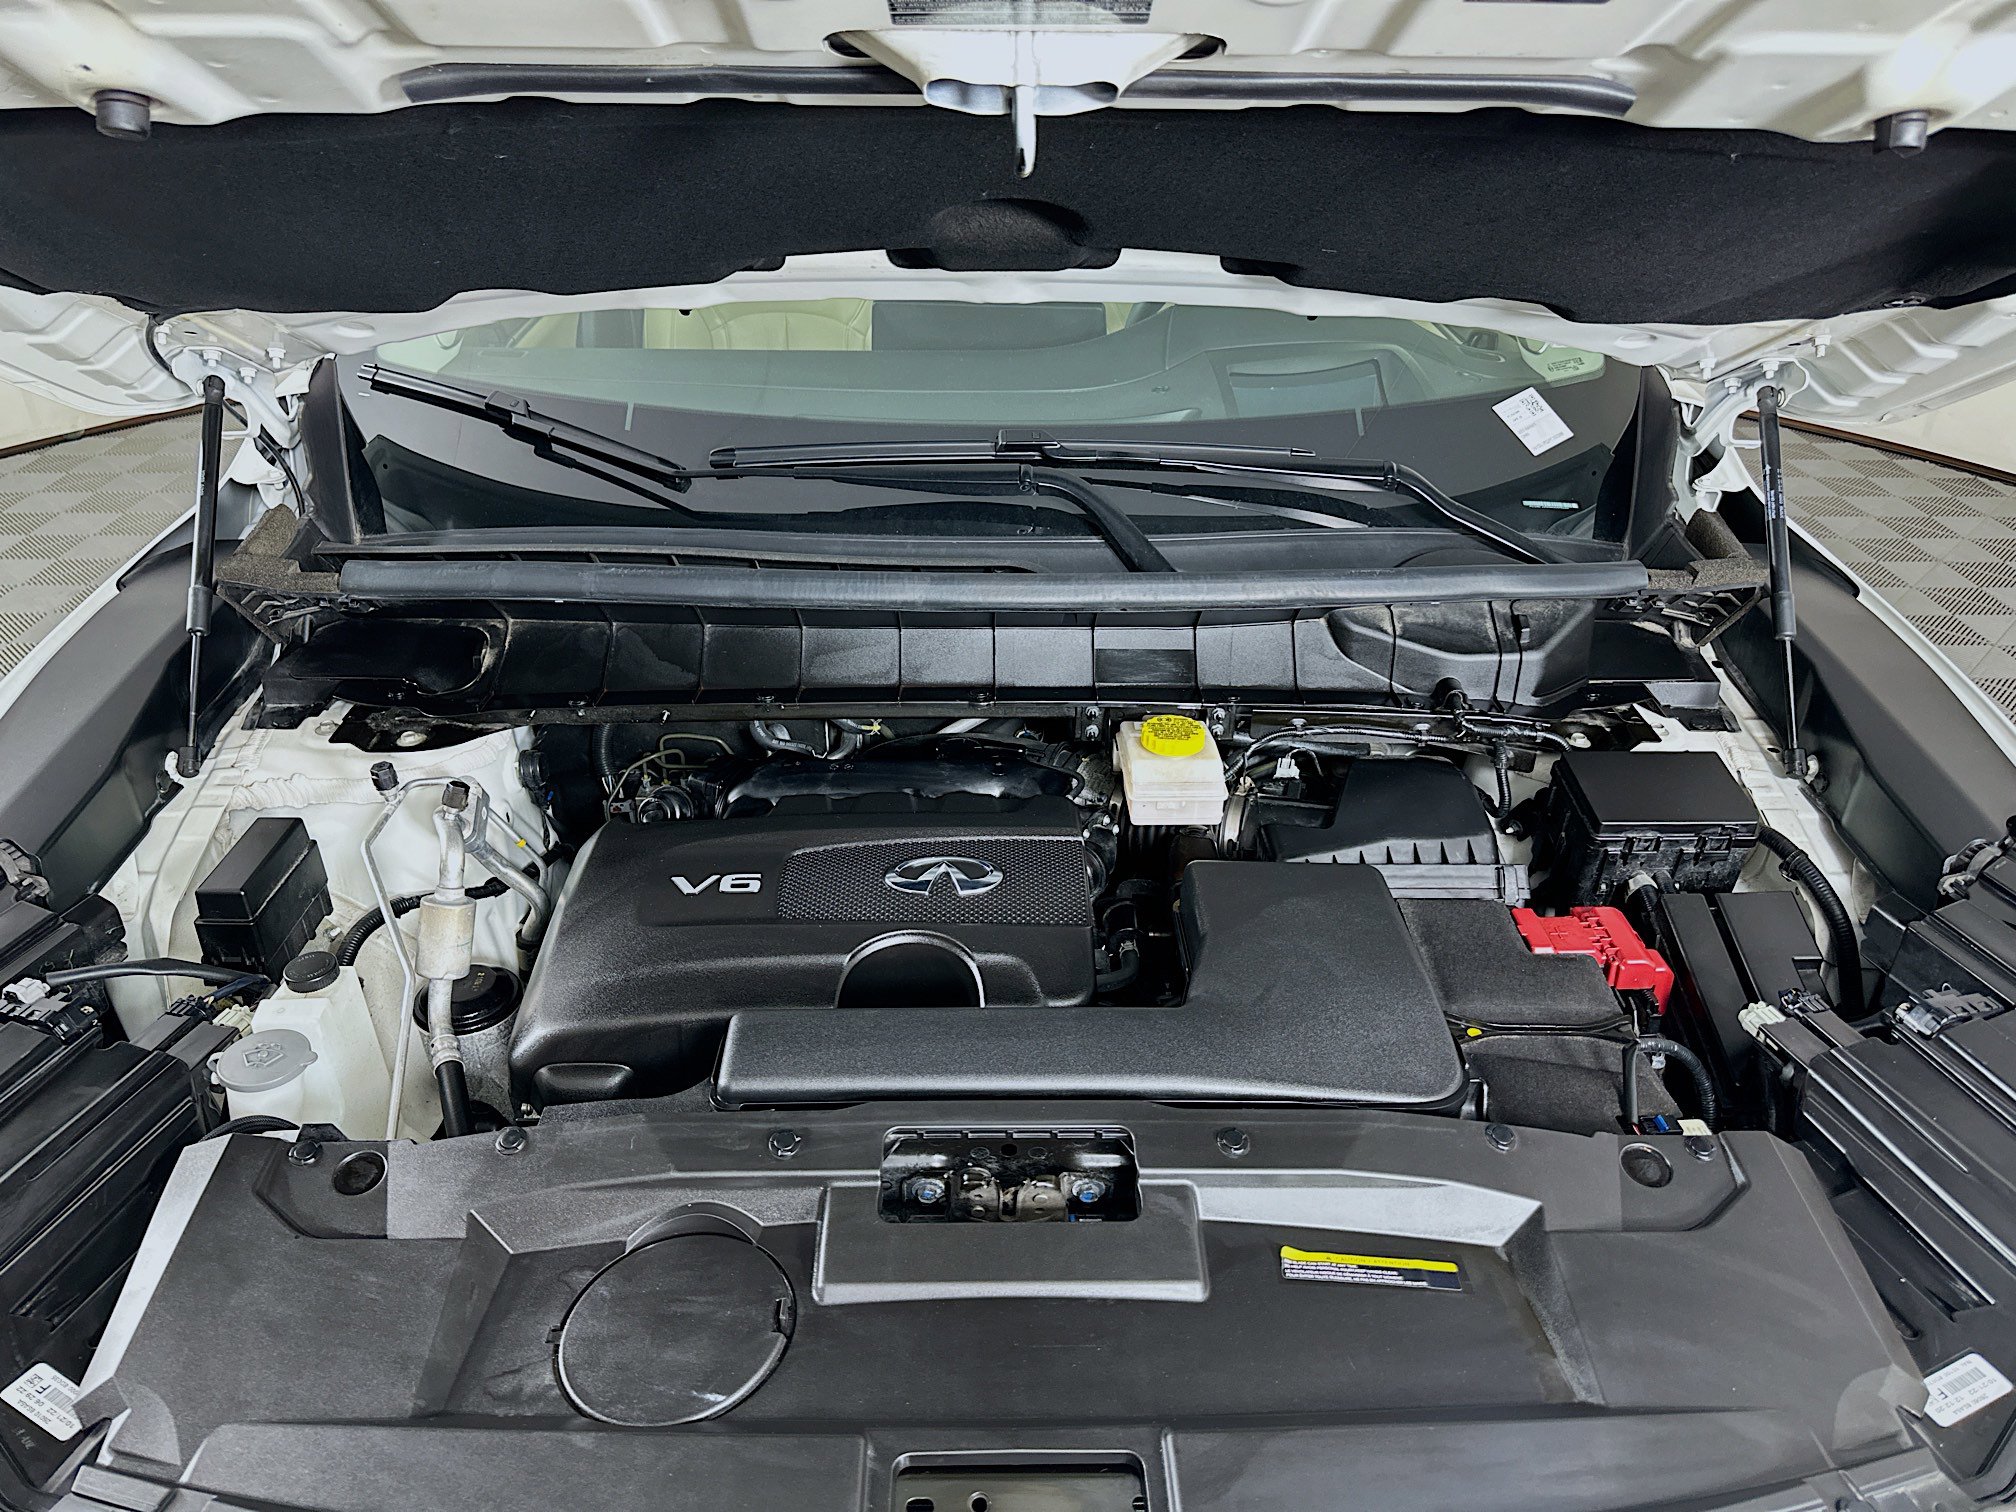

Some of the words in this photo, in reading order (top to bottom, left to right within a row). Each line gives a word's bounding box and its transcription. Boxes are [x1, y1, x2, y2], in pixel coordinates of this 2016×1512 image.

[670, 873, 762, 895] V6
[35, 1384, 52, 1395] F
[1937, 1387, 1949, 1400] F
